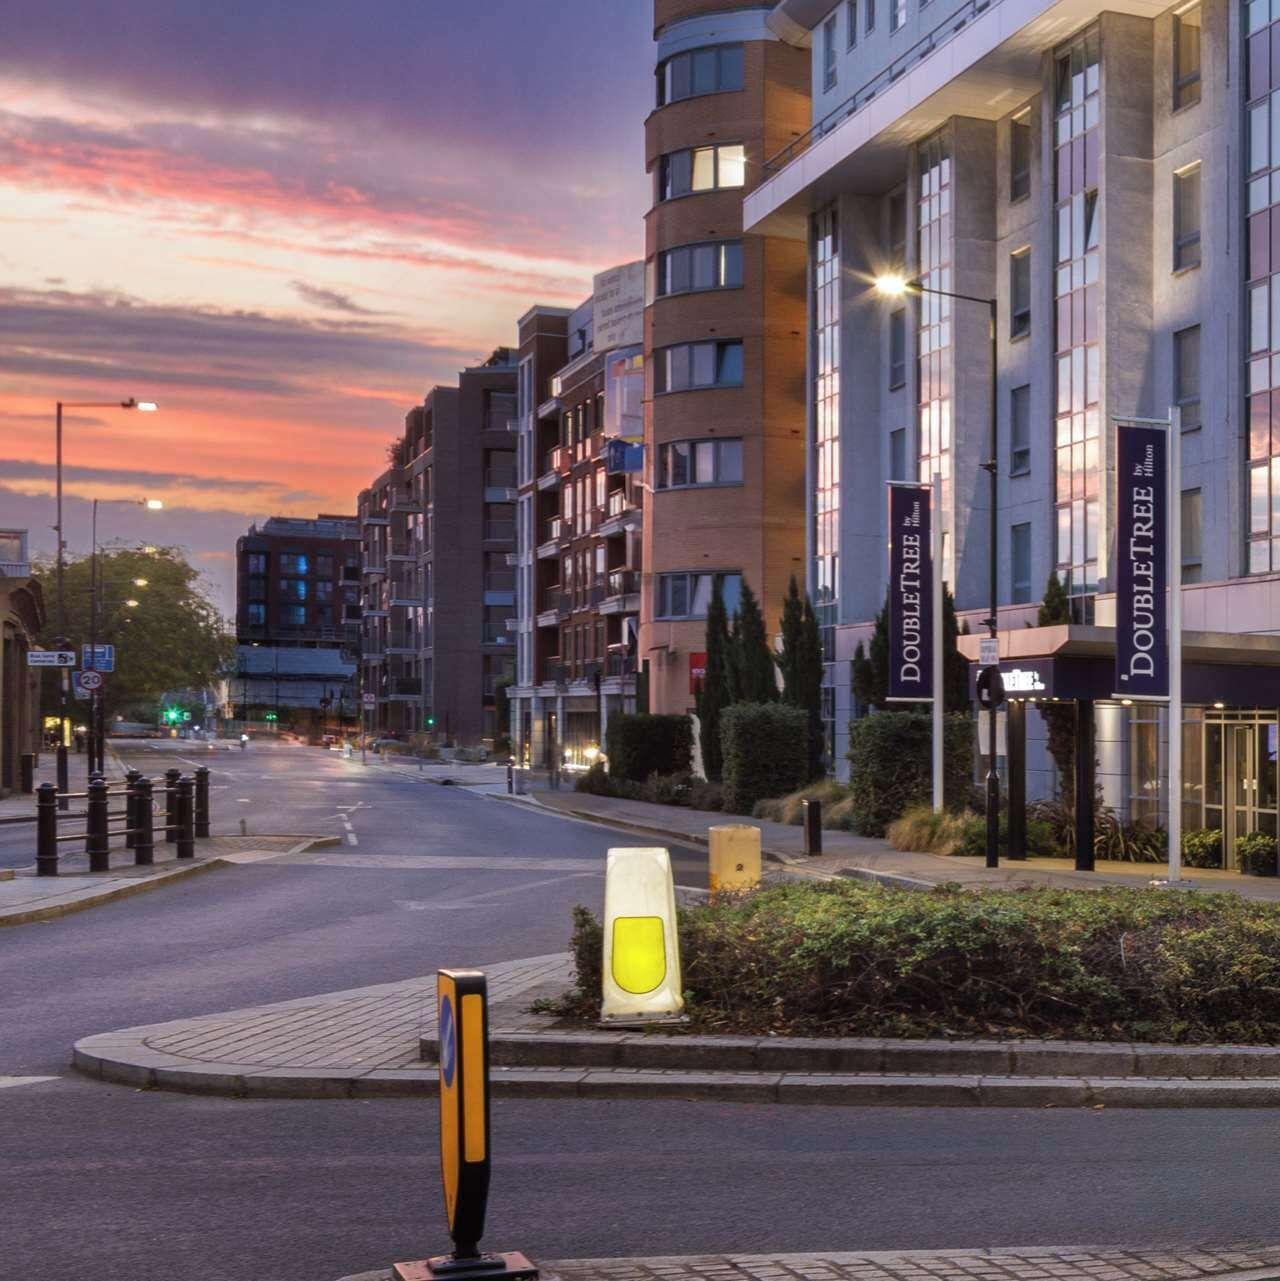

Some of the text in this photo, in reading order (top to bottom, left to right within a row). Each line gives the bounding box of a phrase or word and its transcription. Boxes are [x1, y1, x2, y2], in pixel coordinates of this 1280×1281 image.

[1132, 463, 1142, 476] by
[1143, 444, 1153, 477] Hilton
[1130, 486, 1154, 677] DOUBLETREE
[900, 534, 921, 683] DOUBLETREE
[83, 675, 99, 685] 20
